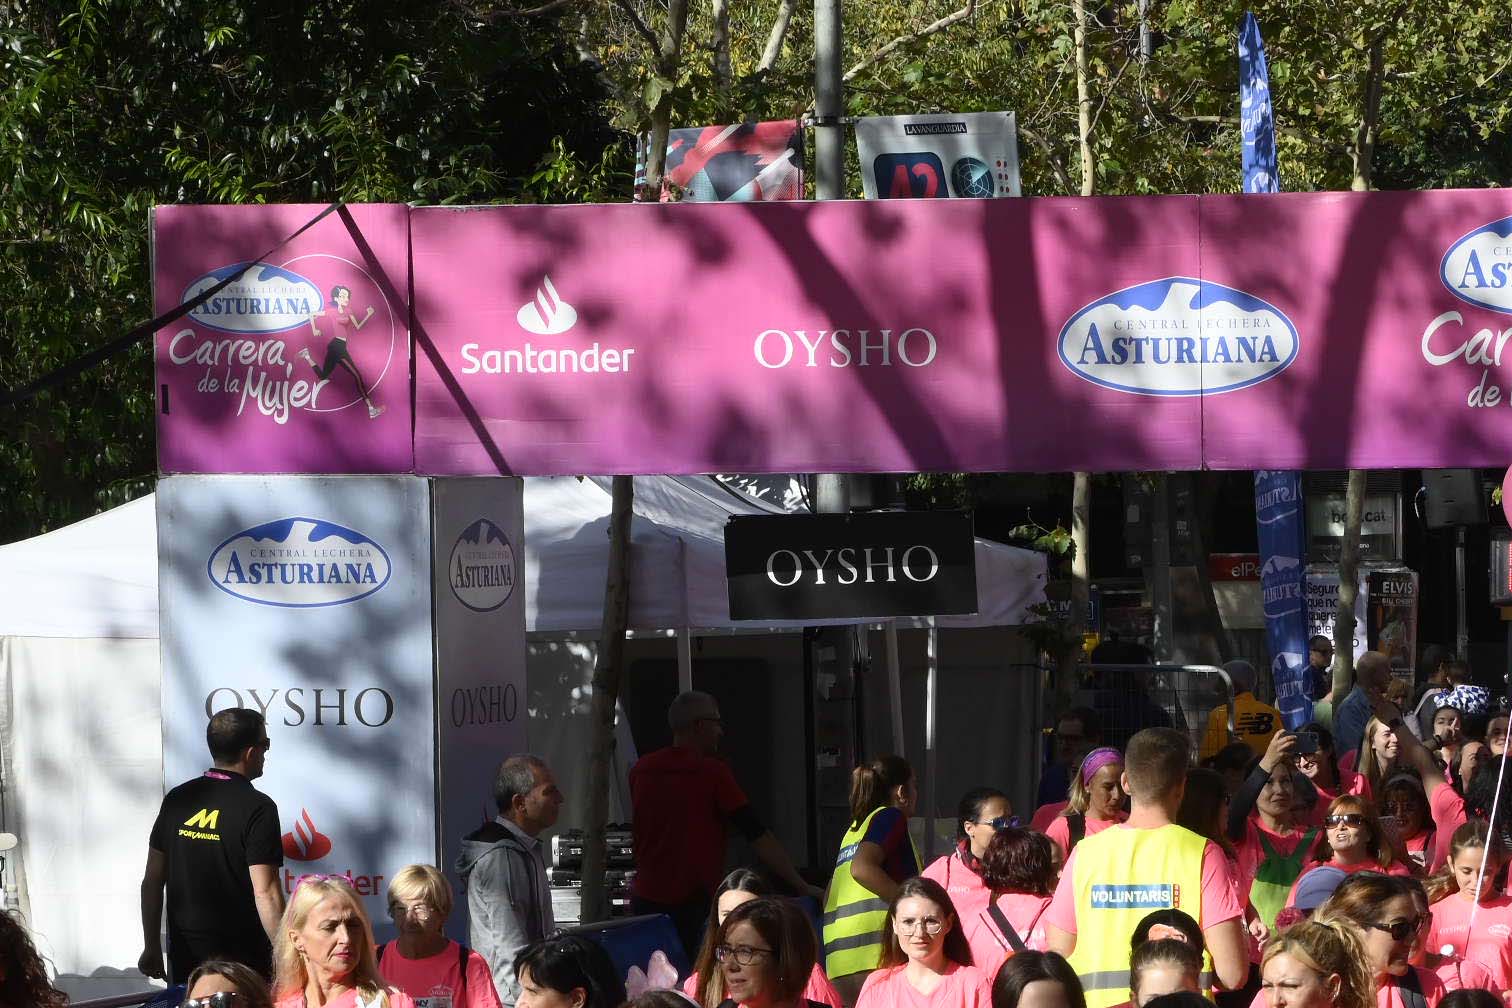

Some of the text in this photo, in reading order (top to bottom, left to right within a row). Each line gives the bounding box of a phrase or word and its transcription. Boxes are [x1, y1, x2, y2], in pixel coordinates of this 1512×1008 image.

[192, 288, 312, 315] ASTURIANA
[1114, 318, 1271, 330] CENTRAL LECHERA
[169, 329, 285, 366] Carrera
[461, 343, 635, 374] Santander
[753, 329, 937, 369] OYSHO
[1077, 322, 1281, 365] ASTURIANA
[198, 368, 241, 393] de la
[237, 364, 330, 424] Mujer
[1468, 369, 1502, 409] de
[222, 550, 378, 584] ASTURIANA
[455, 555, 512, 589] ASTURIANA
[766, 546, 939, 586] OYSHO
[1383, 581, 1413, 593] ELVIS
[205, 687, 394, 728] OYSHO
[451, 684, 517, 728] OYSHO
[1092, 890, 1170, 903] VOLUNTARIS
